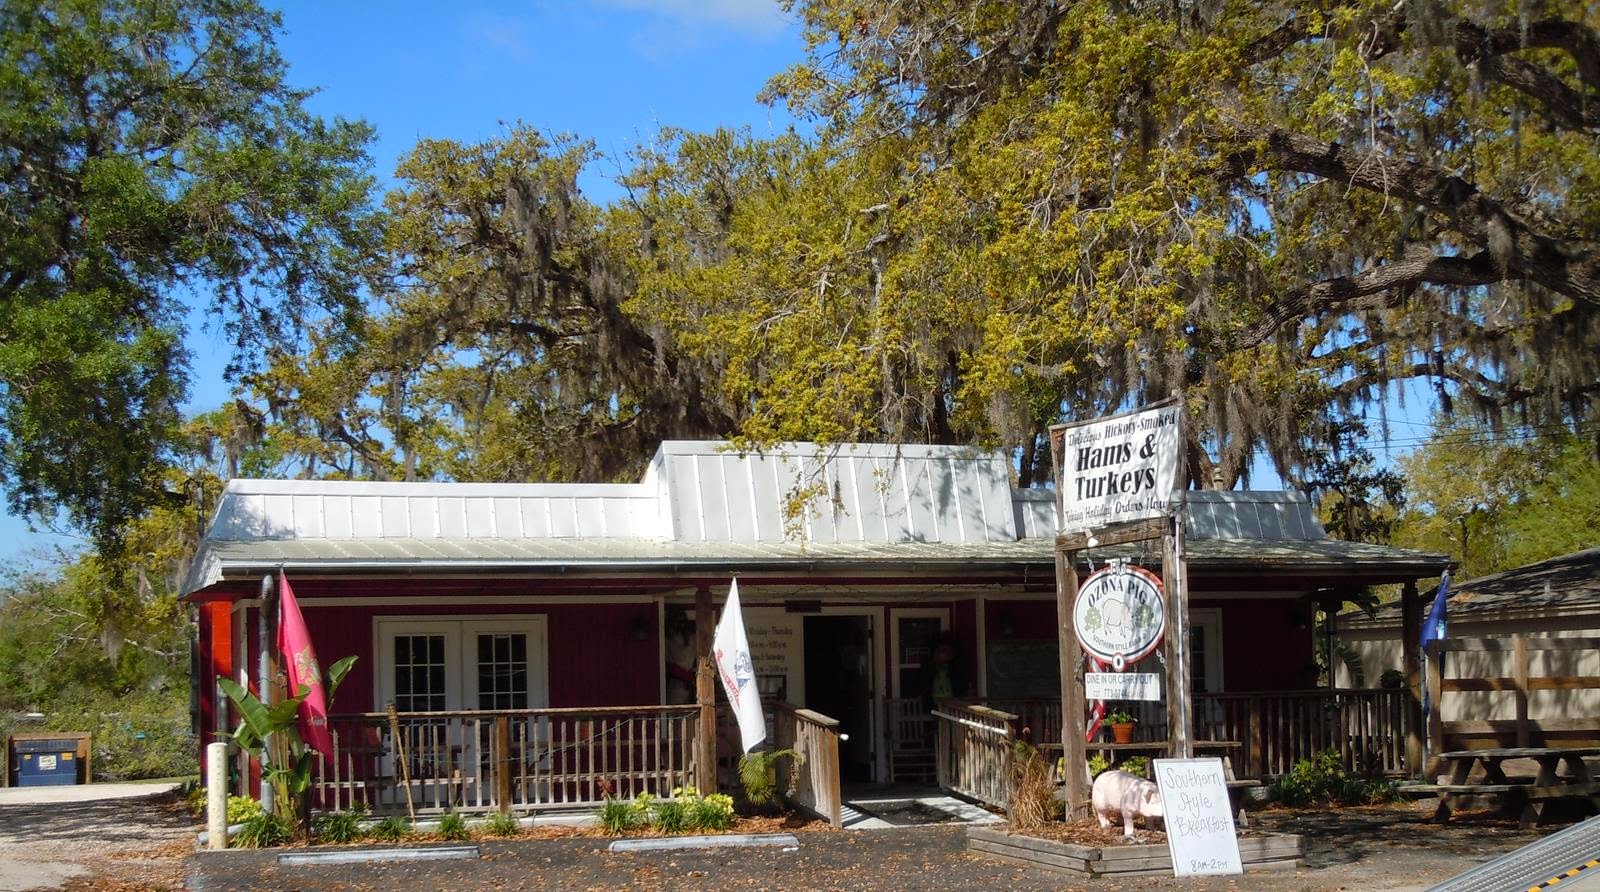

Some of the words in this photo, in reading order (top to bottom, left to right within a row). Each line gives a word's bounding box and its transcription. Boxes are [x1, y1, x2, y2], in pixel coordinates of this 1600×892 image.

[1068, 431, 1102, 447] Delicious
[1104, 411, 1176, 439] Hickory-Smoked
[1076, 441, 1132, 472] Hams
[1139, 433, 1157, 460] &
[1075, 467, 1156, 501] Turkeys
[1085, 503, 1113, 519] Holiday
[1115, 500, 1144, 515] Orders
[1088, 578, 1124, 608] OZONA
[1127, 580, 1148, 606] PIG
[1086, 674, 1100, 685] DINE
[1101, 674, 1107, 685] IN
[1109, 674, 1118, 685] OR
[1119, 674, 1139, 685] CARRY
[1140, 674, 1153, 685] OUT
[1165, 767, 1222, 789] Southern
[1178, 791, 1213, 818] Style
[1174, 815, 1230, 838] Breakfast
